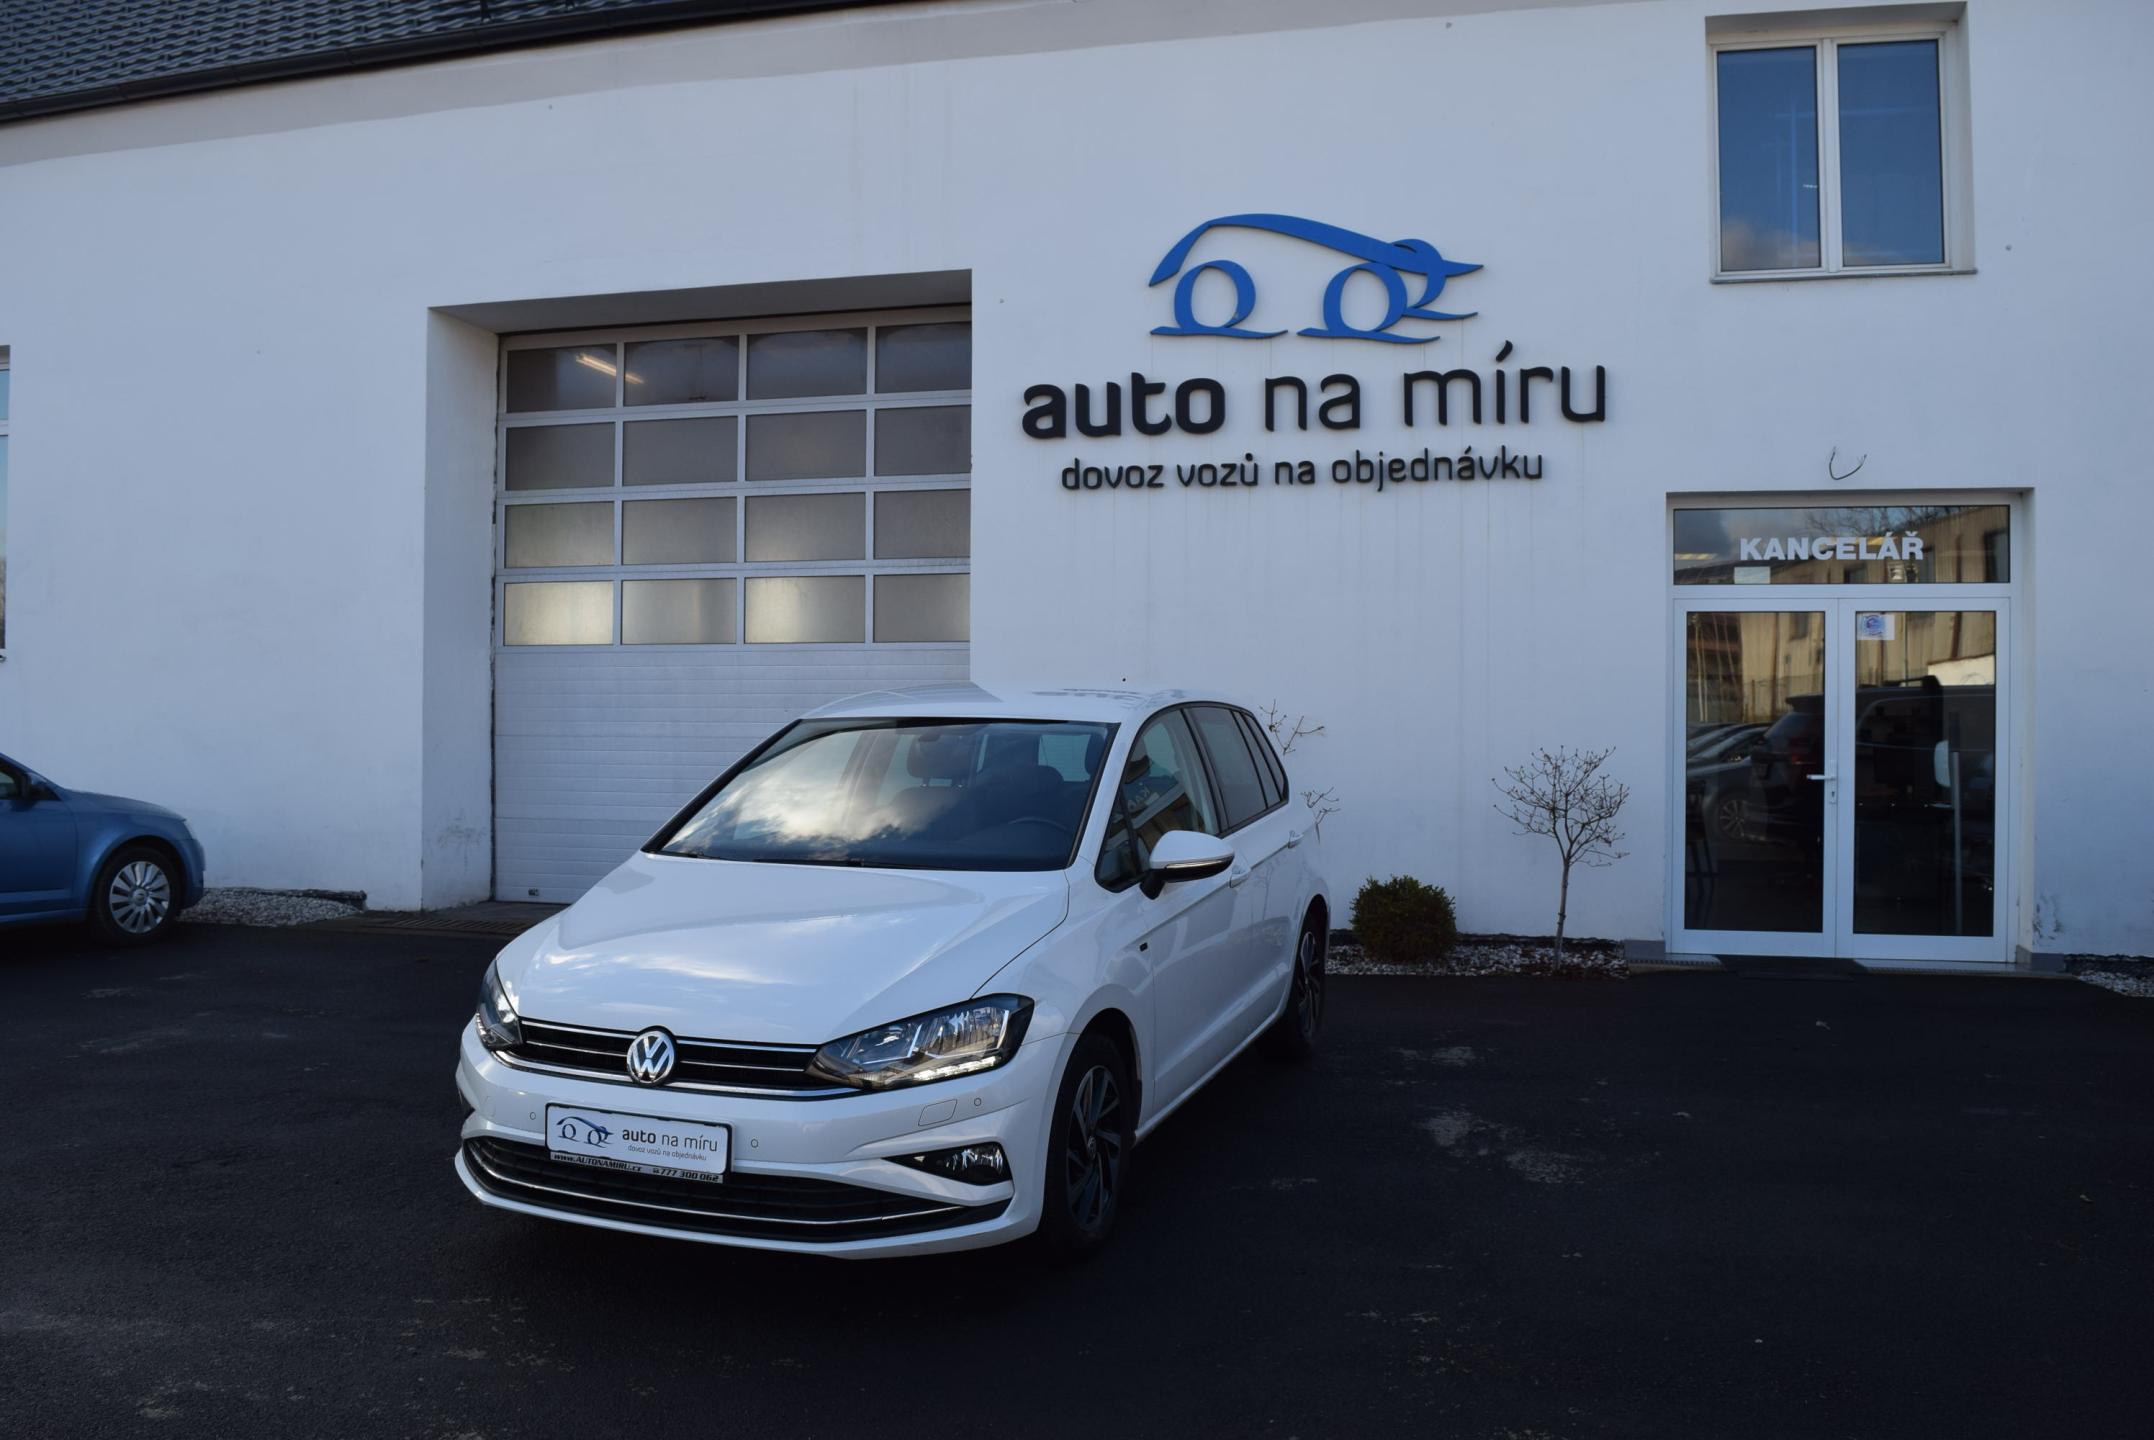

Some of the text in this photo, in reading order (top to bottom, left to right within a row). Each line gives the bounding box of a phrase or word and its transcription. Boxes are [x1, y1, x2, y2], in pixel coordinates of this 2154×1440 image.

[1022, 340, 1606, 441] auto na míru
[1062, 444, 1543, 493] dovoz vozů na objednávku
[1740, 531, 1924, 561] KANCELÁŘ
[622, 1129, 718, 1152] auto na míru
